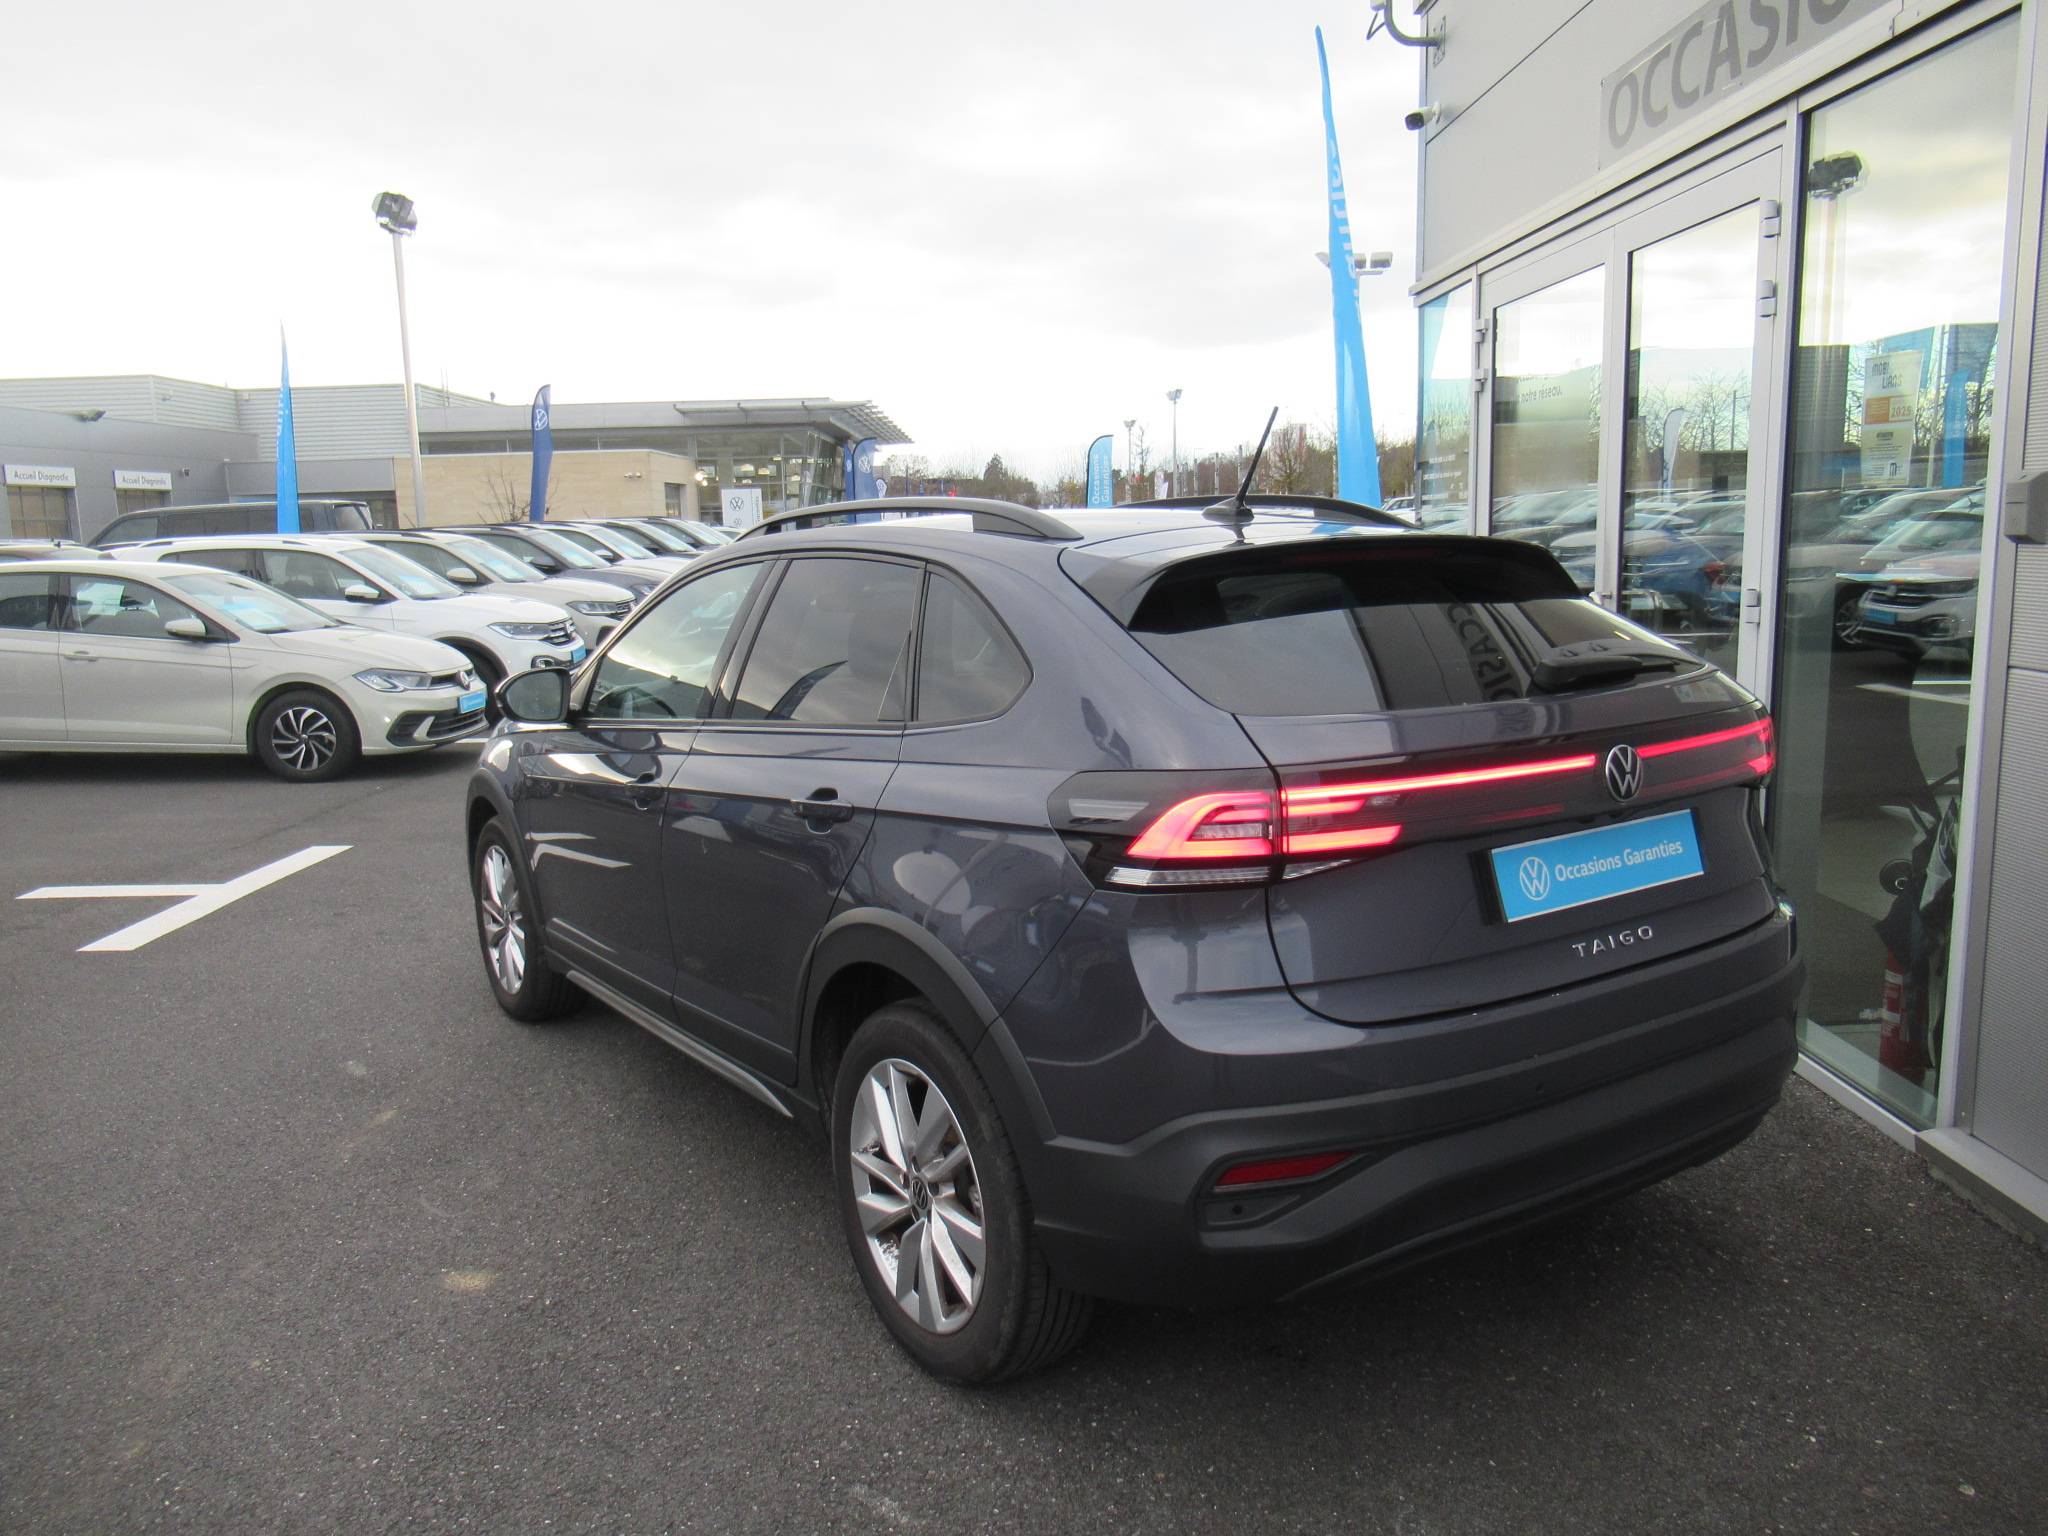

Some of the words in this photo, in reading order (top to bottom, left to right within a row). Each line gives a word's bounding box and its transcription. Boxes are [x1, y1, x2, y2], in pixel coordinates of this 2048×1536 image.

[14, 470, 37, 480] Accueil
[1554, 856, 1622, 882] Occasions
[1623, 840, 1684, 866] Garanties
[1572, 925, 1653, 958] TAIGO
